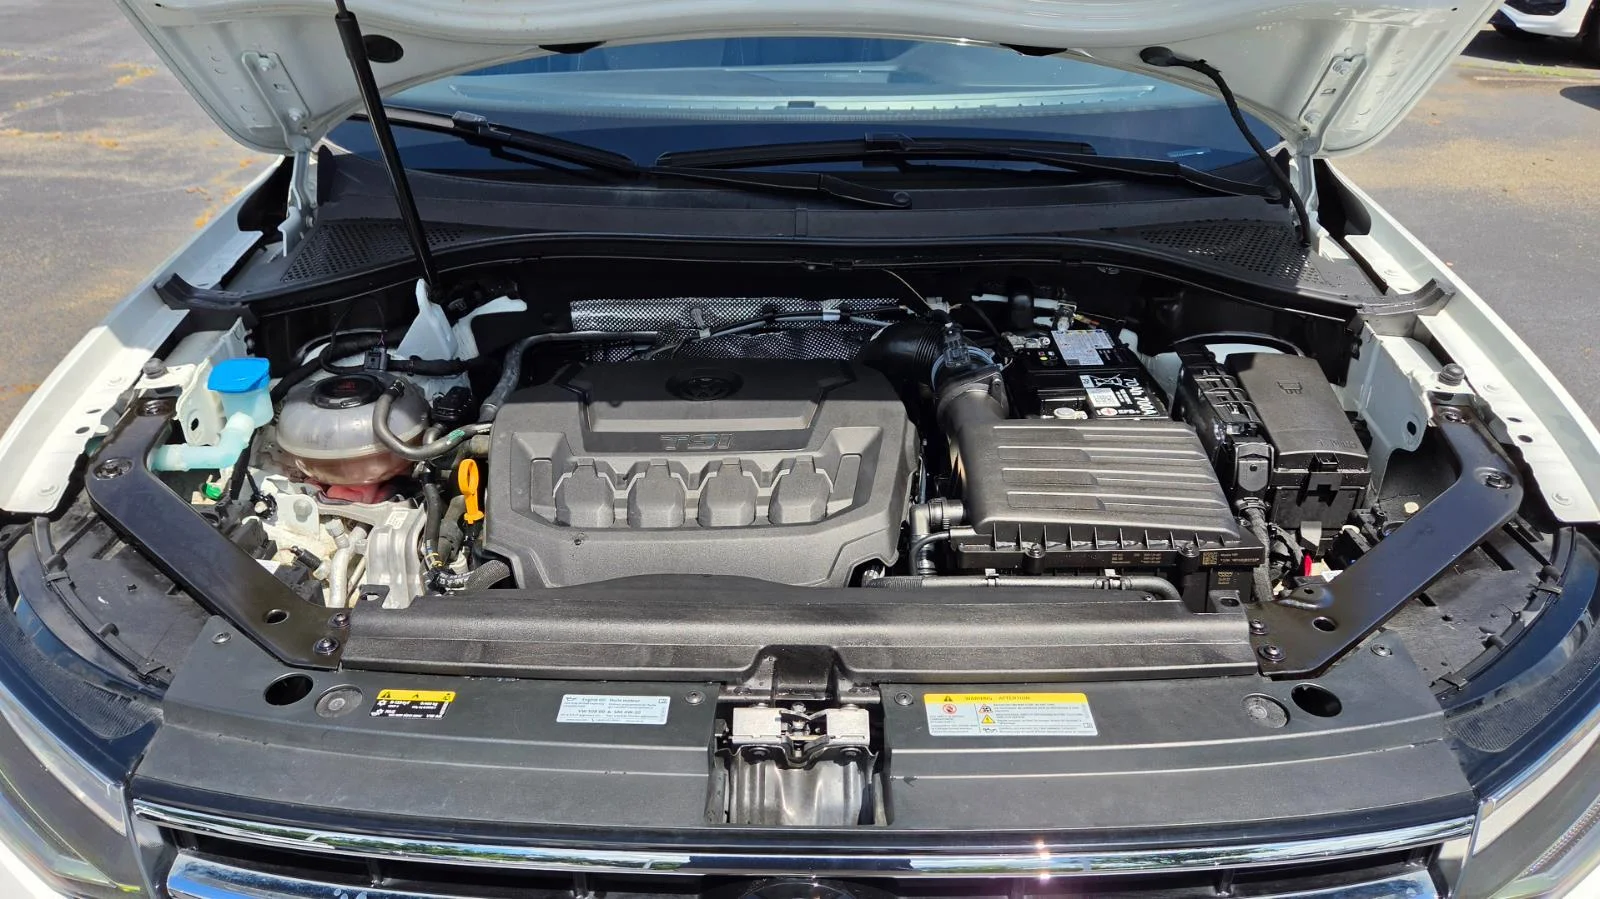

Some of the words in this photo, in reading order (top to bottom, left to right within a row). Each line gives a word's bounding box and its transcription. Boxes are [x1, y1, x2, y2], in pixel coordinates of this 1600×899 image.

[1124, 377, 1145, 396] 70Ah
[1134, 396, 1158, 416] 700A
[660, 433, 734, 451] TSI
